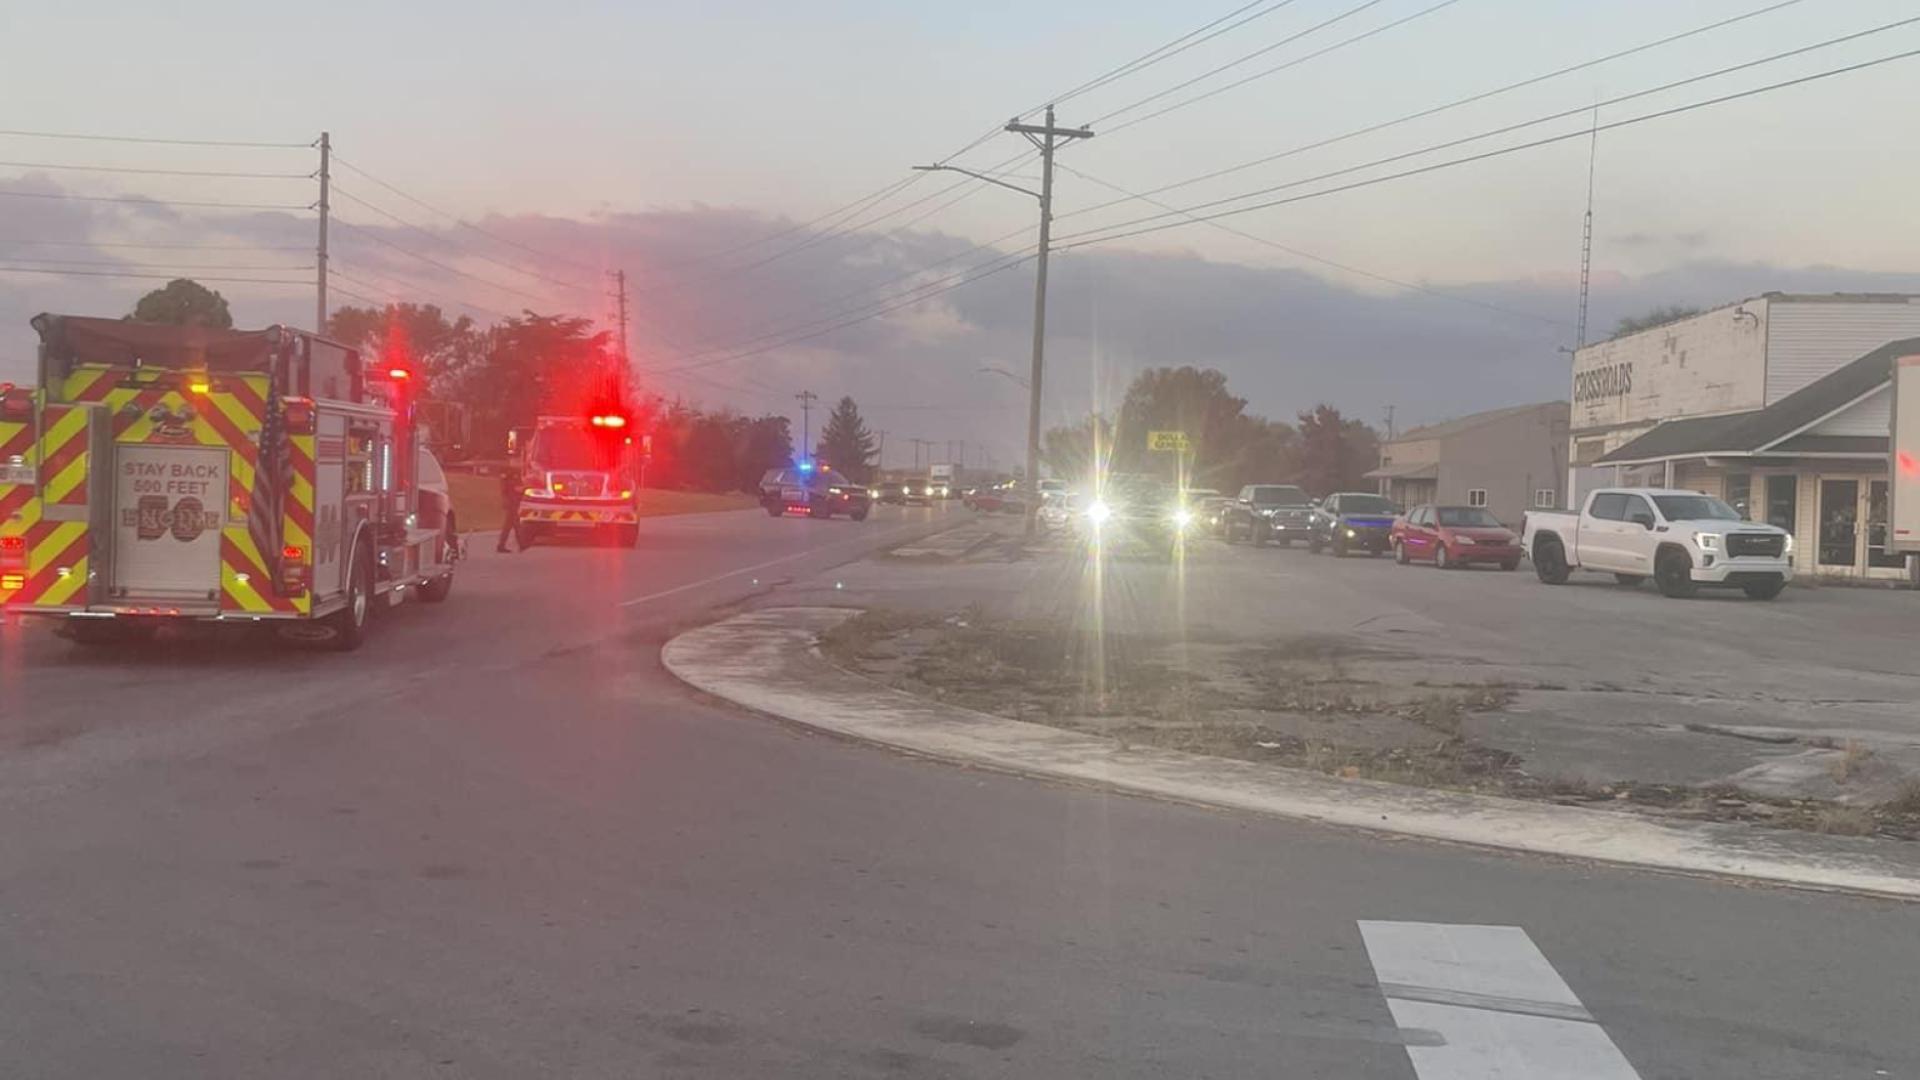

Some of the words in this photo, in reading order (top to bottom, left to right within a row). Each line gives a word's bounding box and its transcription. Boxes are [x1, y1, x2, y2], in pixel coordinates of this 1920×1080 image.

[1575, 362, 1633, 401] CROSSROADS
[127, 462, 167, 476] STAY
[170, 464, 219, 478] BACK
[133, 479, 162, 493] 500
[166, 481, 209, 495] FEET
